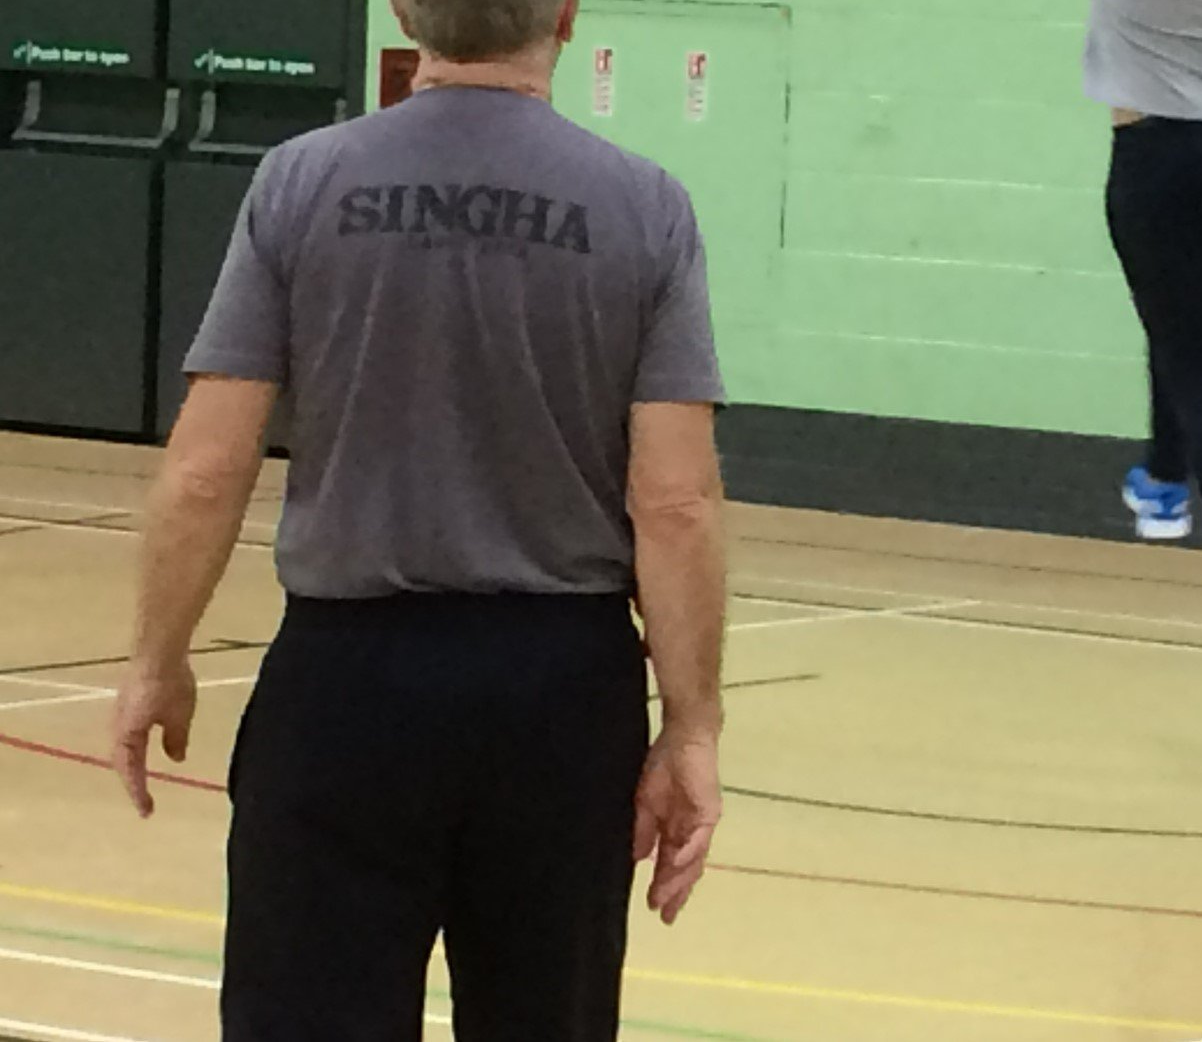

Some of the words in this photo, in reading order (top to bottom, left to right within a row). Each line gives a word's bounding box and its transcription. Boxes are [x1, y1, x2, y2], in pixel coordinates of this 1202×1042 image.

[30, 45, 60, 62] Push
[213, 55, 244, 69] Push
[338, 184, 592, 254] SINGHA
